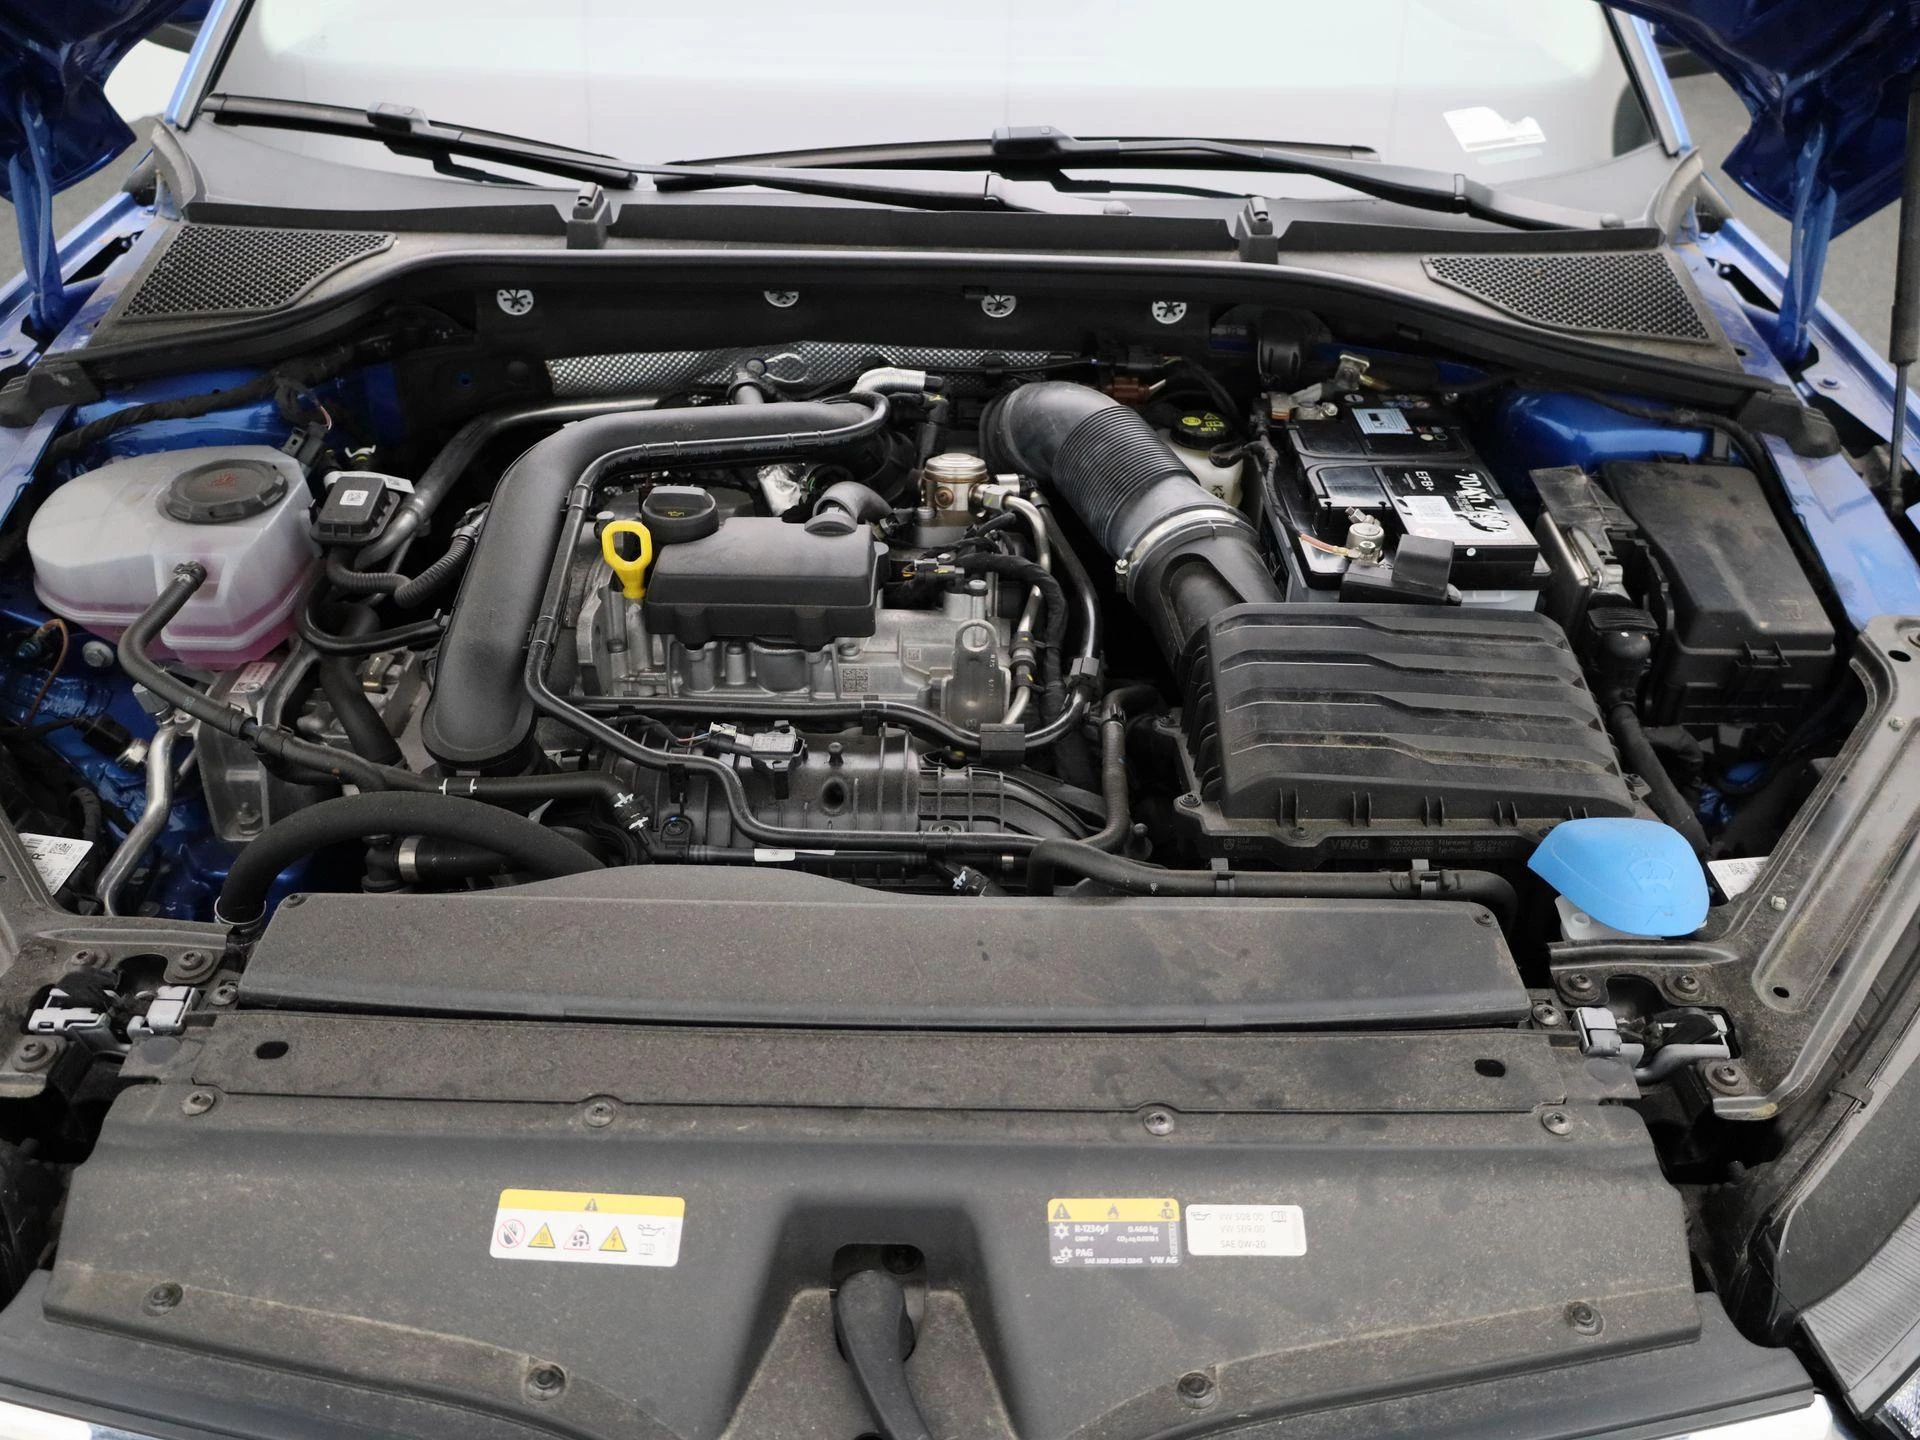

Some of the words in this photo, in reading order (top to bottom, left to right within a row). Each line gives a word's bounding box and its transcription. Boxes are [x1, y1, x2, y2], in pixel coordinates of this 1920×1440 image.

[1415, 471, 1434, 491] EFB+
[1454, 473, 1492, 503] 70Ah
[1074, 1224, 1109, 1235] R-1234yf
[1220, 1240, 1237, 1248] SAE
[1075, 1248, 1093, 1257] PAG
[1150, 1256, 1164, 1264] VW
